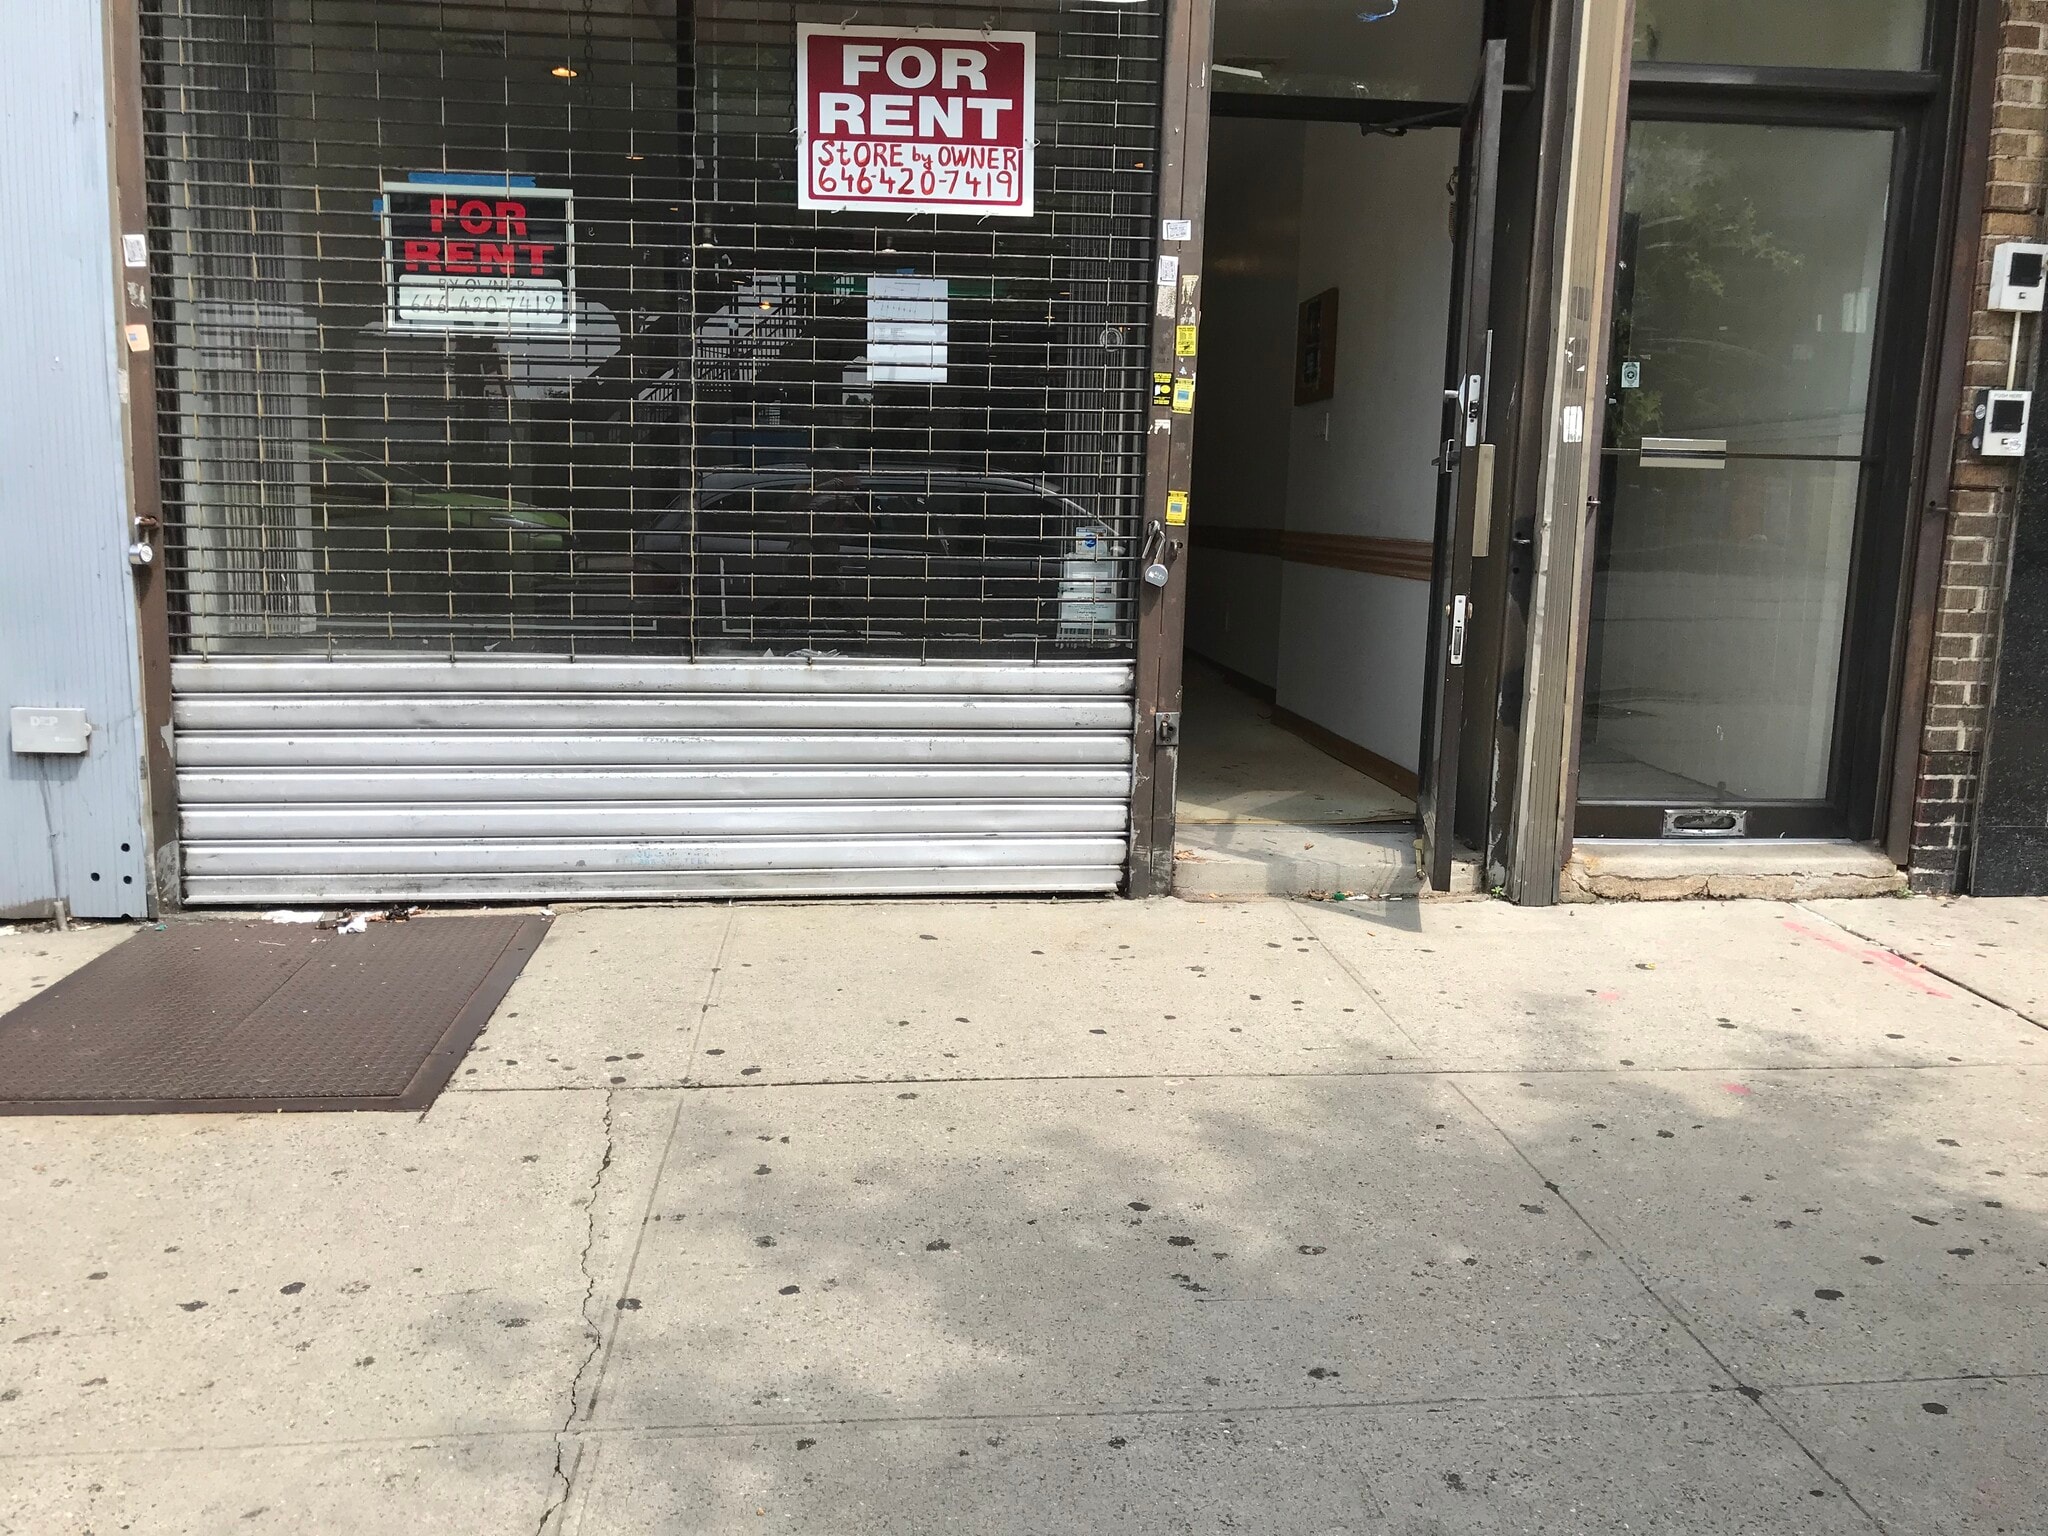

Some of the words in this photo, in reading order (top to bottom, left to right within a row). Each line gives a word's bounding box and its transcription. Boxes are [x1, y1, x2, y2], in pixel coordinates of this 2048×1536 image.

[842, 44, 988, 91] FOR
[819, 92, 1013, 140] RENT
[912, 145, 933, 171] by
[938, 146, 1017, 171] OWNER
[818, 166, 1013, 198] 646-420-7419
[429, 198, 528, 236] FOR
[404, 240, 555, 275] RENT
[465, 278, 526, 294] OWNER
